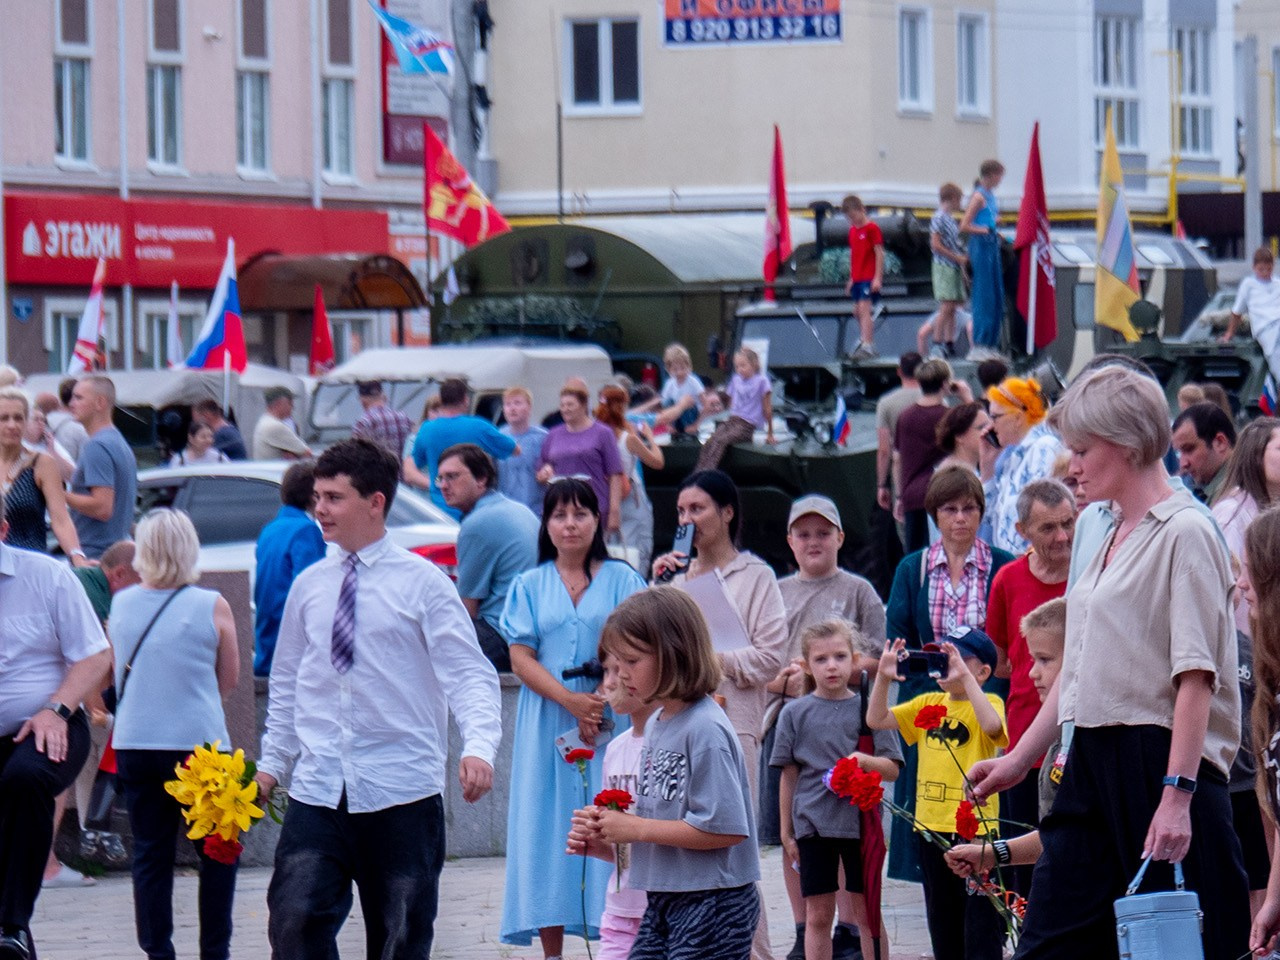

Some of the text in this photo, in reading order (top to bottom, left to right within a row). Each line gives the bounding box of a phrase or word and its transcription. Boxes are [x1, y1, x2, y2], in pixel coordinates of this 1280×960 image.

[672, 15, 838, 42] 8 920 913 32 16
